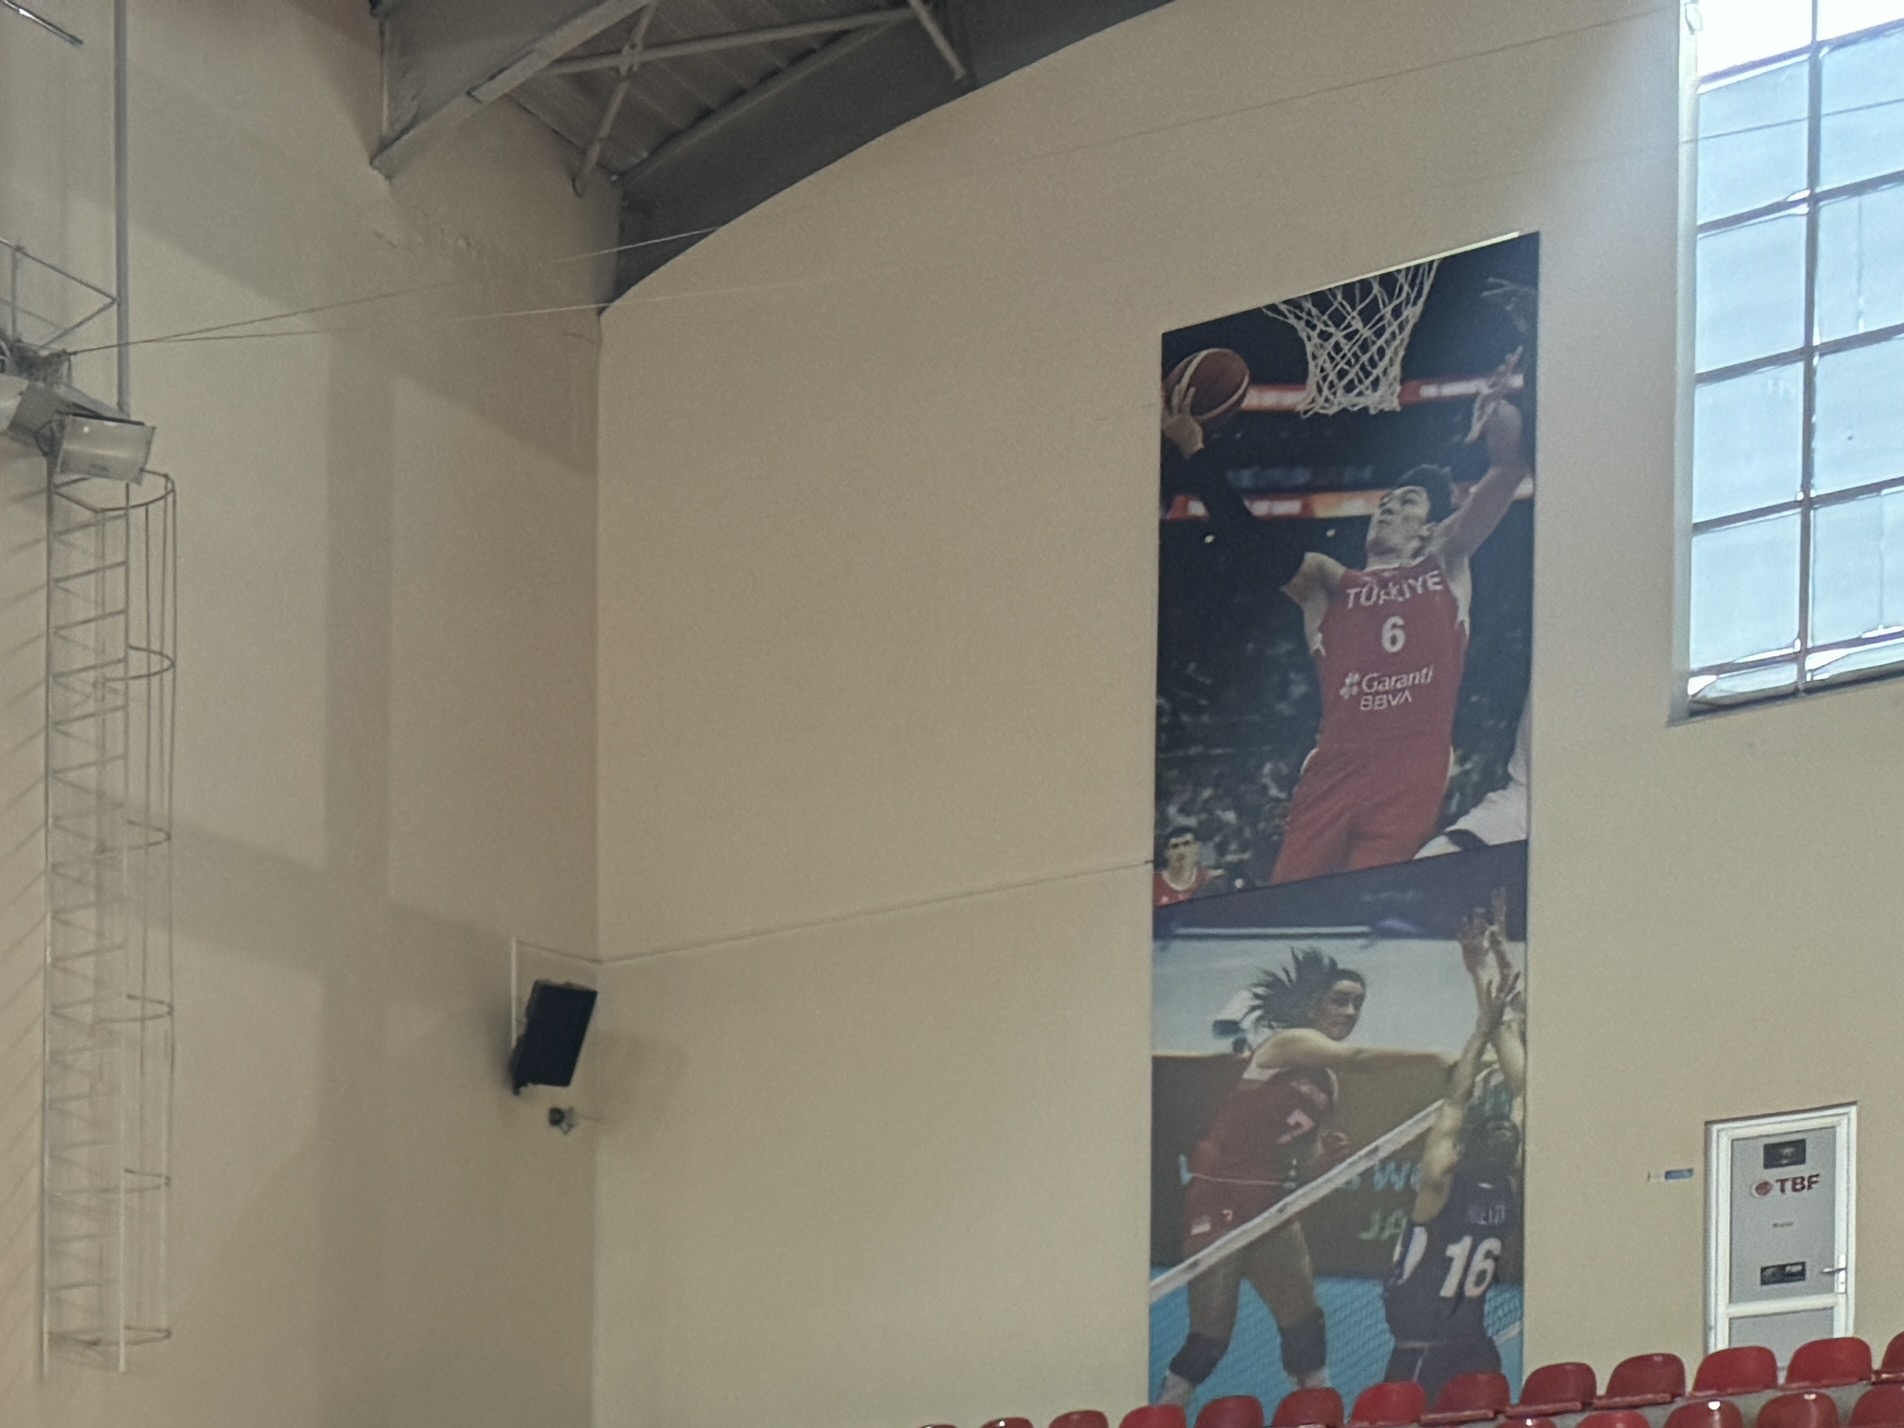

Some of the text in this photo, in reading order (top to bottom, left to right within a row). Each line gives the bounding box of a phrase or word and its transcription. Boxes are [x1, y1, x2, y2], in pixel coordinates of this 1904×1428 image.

[1381, 616, 1405, 653] 6
[1362, 665, 1434, 693] Garanti
[1360, 690, 1412, 711] BBVA
[1775, 1173, 1821, 1194] TBF
[1439, 1235, 1502, 1298] 16
